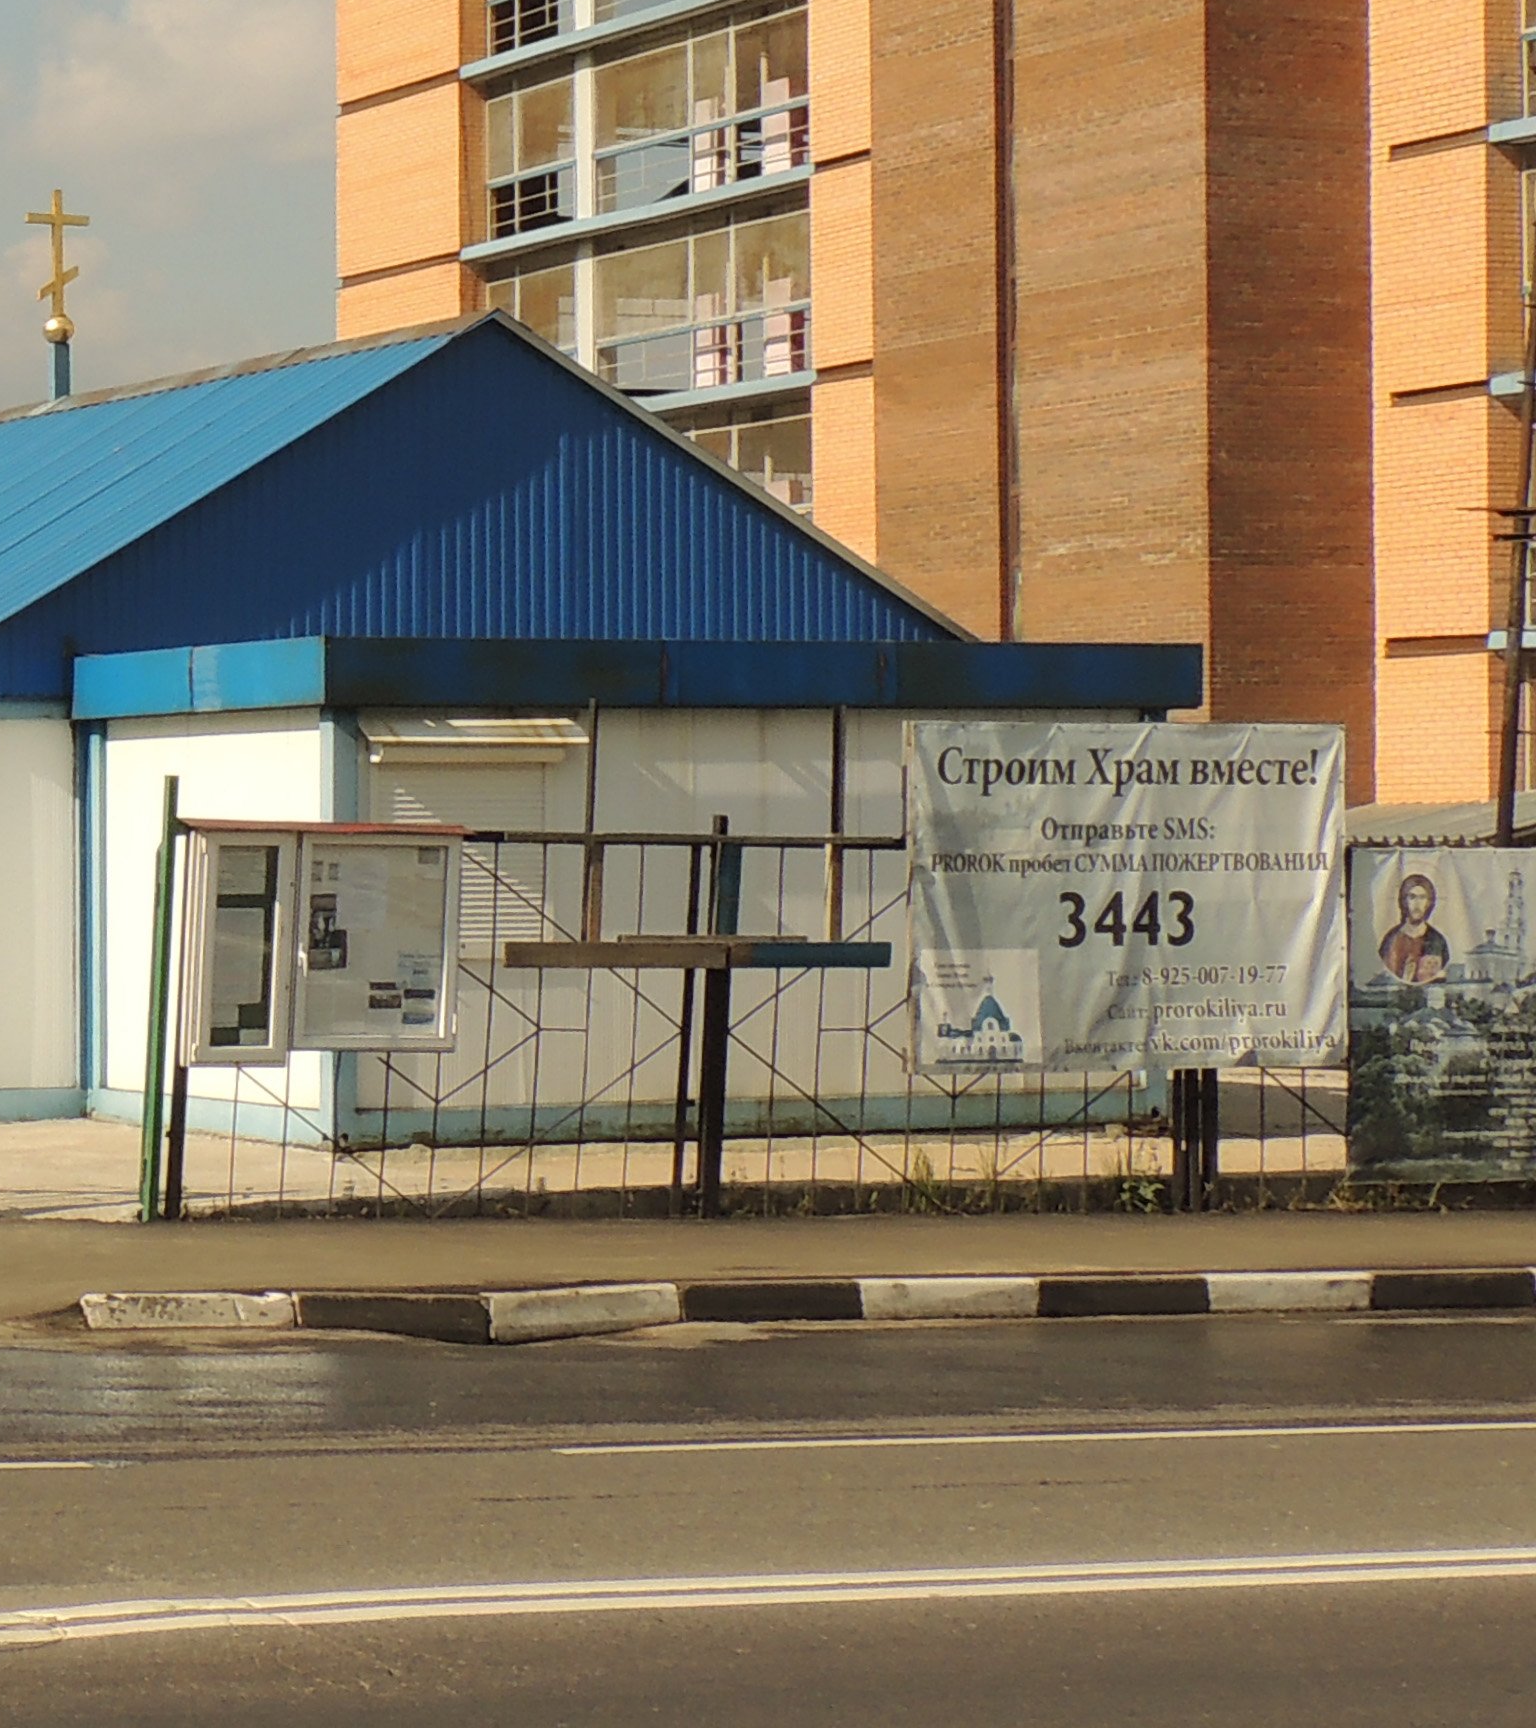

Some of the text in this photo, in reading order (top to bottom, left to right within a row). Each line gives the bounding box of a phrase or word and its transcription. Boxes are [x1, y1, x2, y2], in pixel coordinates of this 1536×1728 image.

[937, 746, 1319, 797] Строим Храм вместе!
[1040, 817, 1216, 847] Отправьте SMS:
[931, 852, 1006, 873] PROROK
[1074, 852, 1149, 874] СУММА
[1151, 852, 1329, 873] ПОЖЕРТВОВАНИЯ
[1058, 890, 1195, 949] 3443
[1141, 965, 1288, 986] 8-925-007-19-77
[1153, 998, 1287, 1025] prorokiliya.ru
[1150, 1029, 1339, 1057] vk.com/prorokiliya
